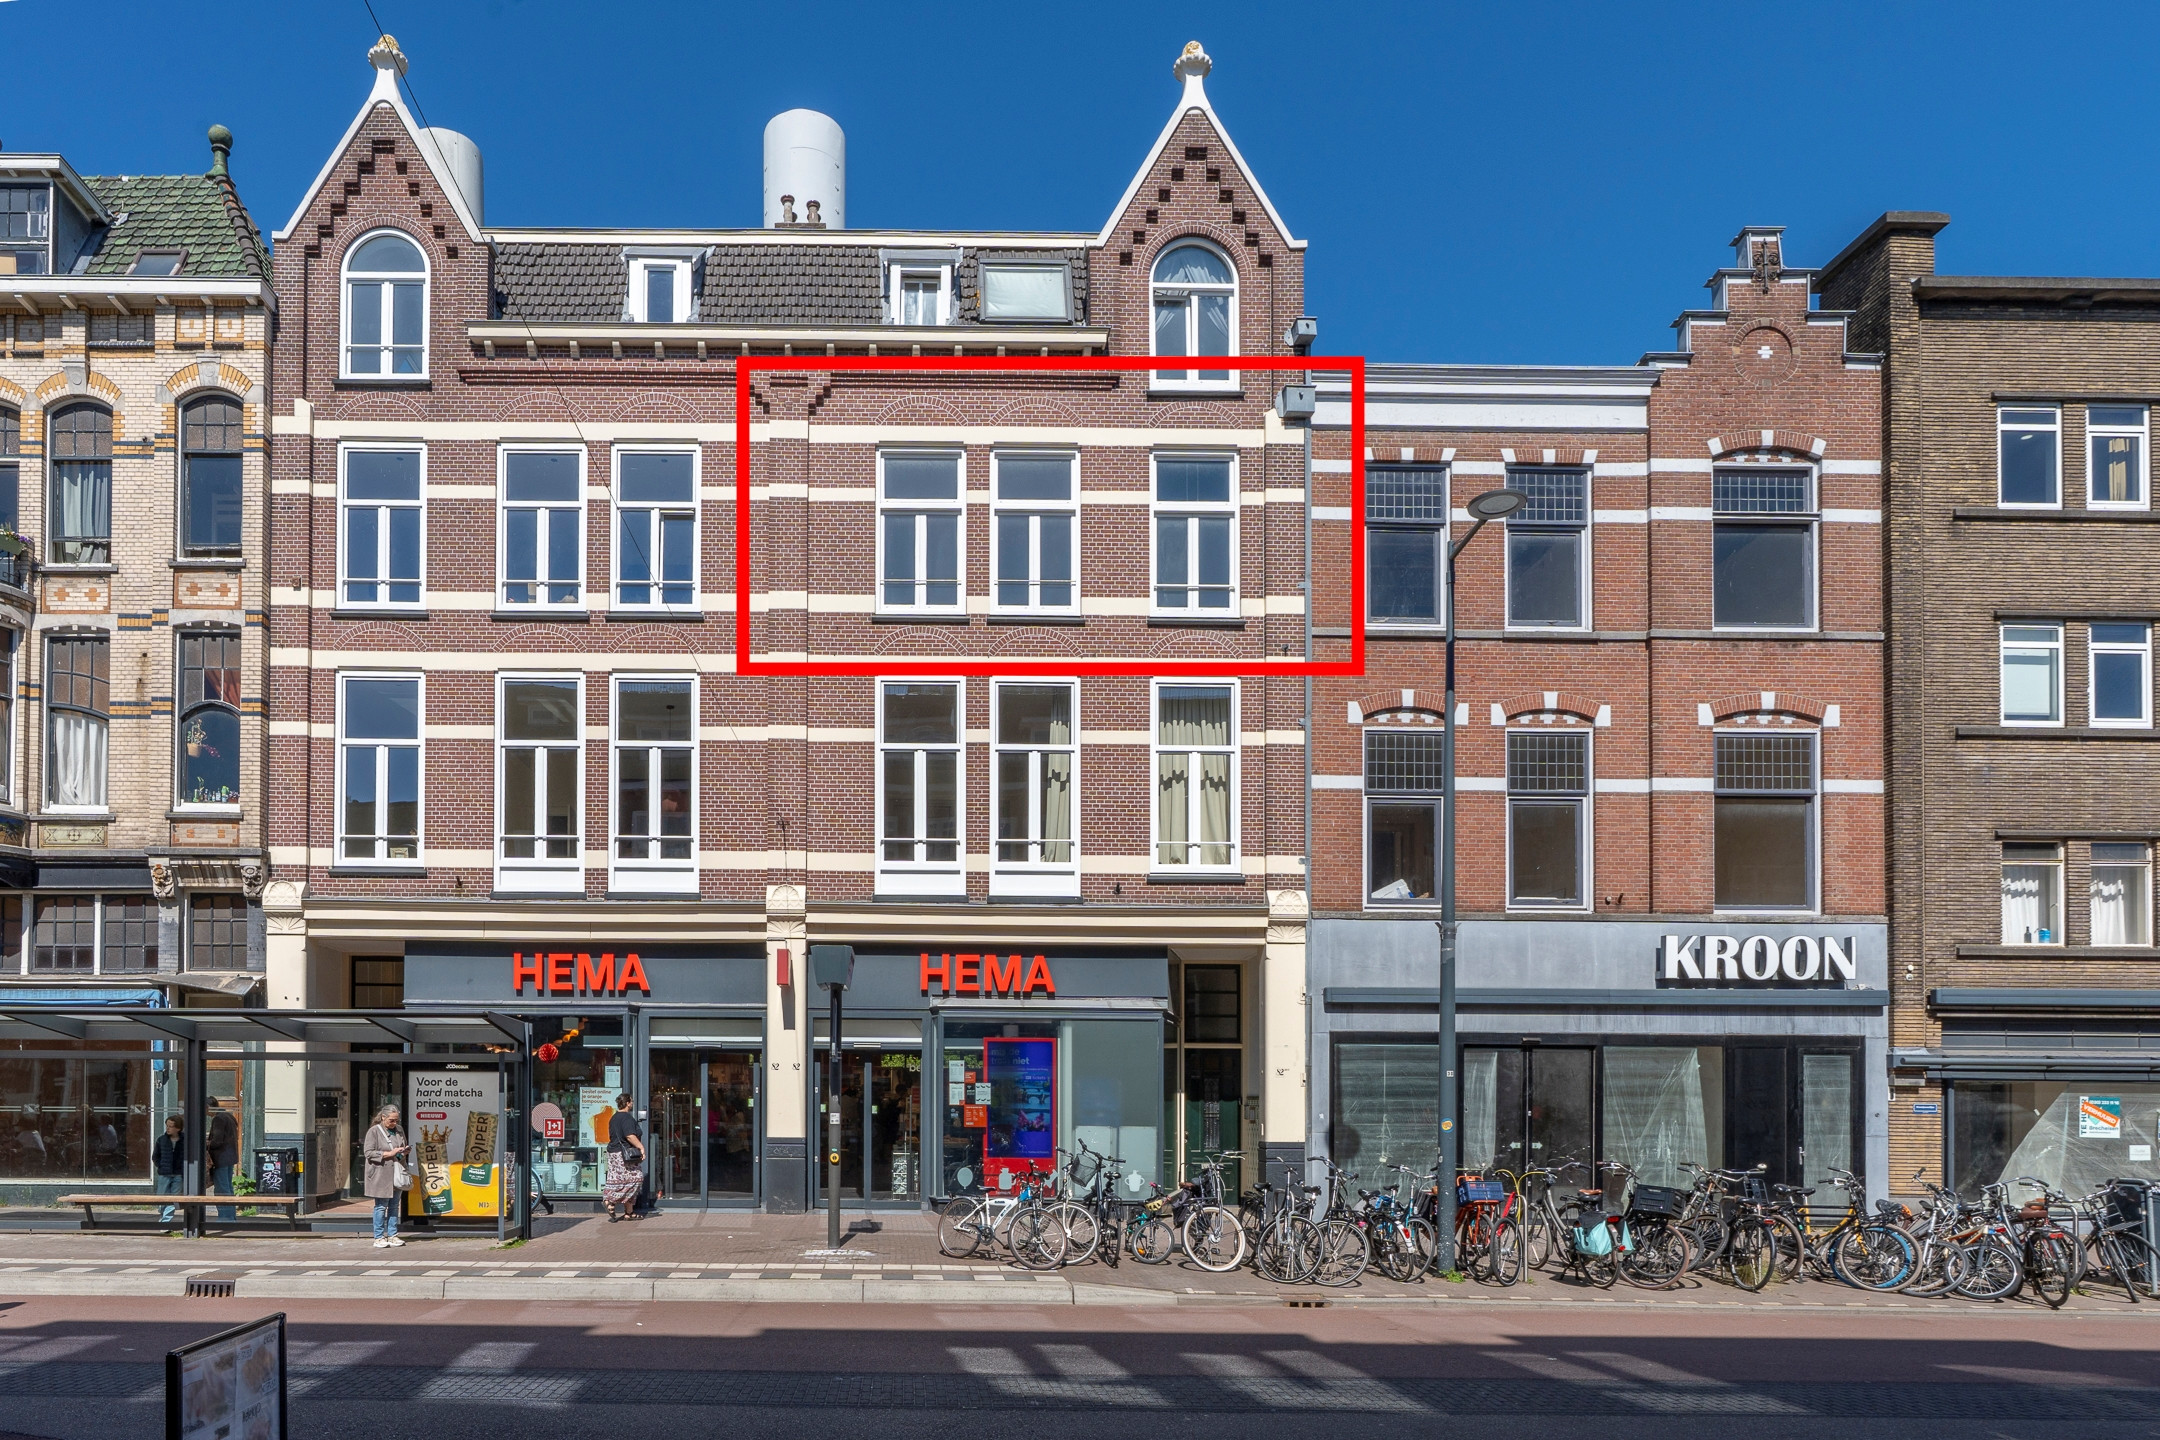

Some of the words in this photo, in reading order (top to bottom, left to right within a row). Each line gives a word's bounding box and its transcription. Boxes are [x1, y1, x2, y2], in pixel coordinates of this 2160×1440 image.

[1665, 935, 1856, 981] KROON
[513, 953, 651, 990] HEMA
[920, 953, 1056, 992] HEMA
[1012, 1057, 1030, 1065] niet
[416, 1077, 442, 1086] Voor
[445, 1077, 458, 1086] de
[416, 1088, 442, 1097] hard
[444, 1088, 483, 1097] matcha
[416, 1099, 461, 1110] princess
[2084, 1104, 2117, 1124] VERHUURD
[546, 1121, 562, 1130] 1+1
